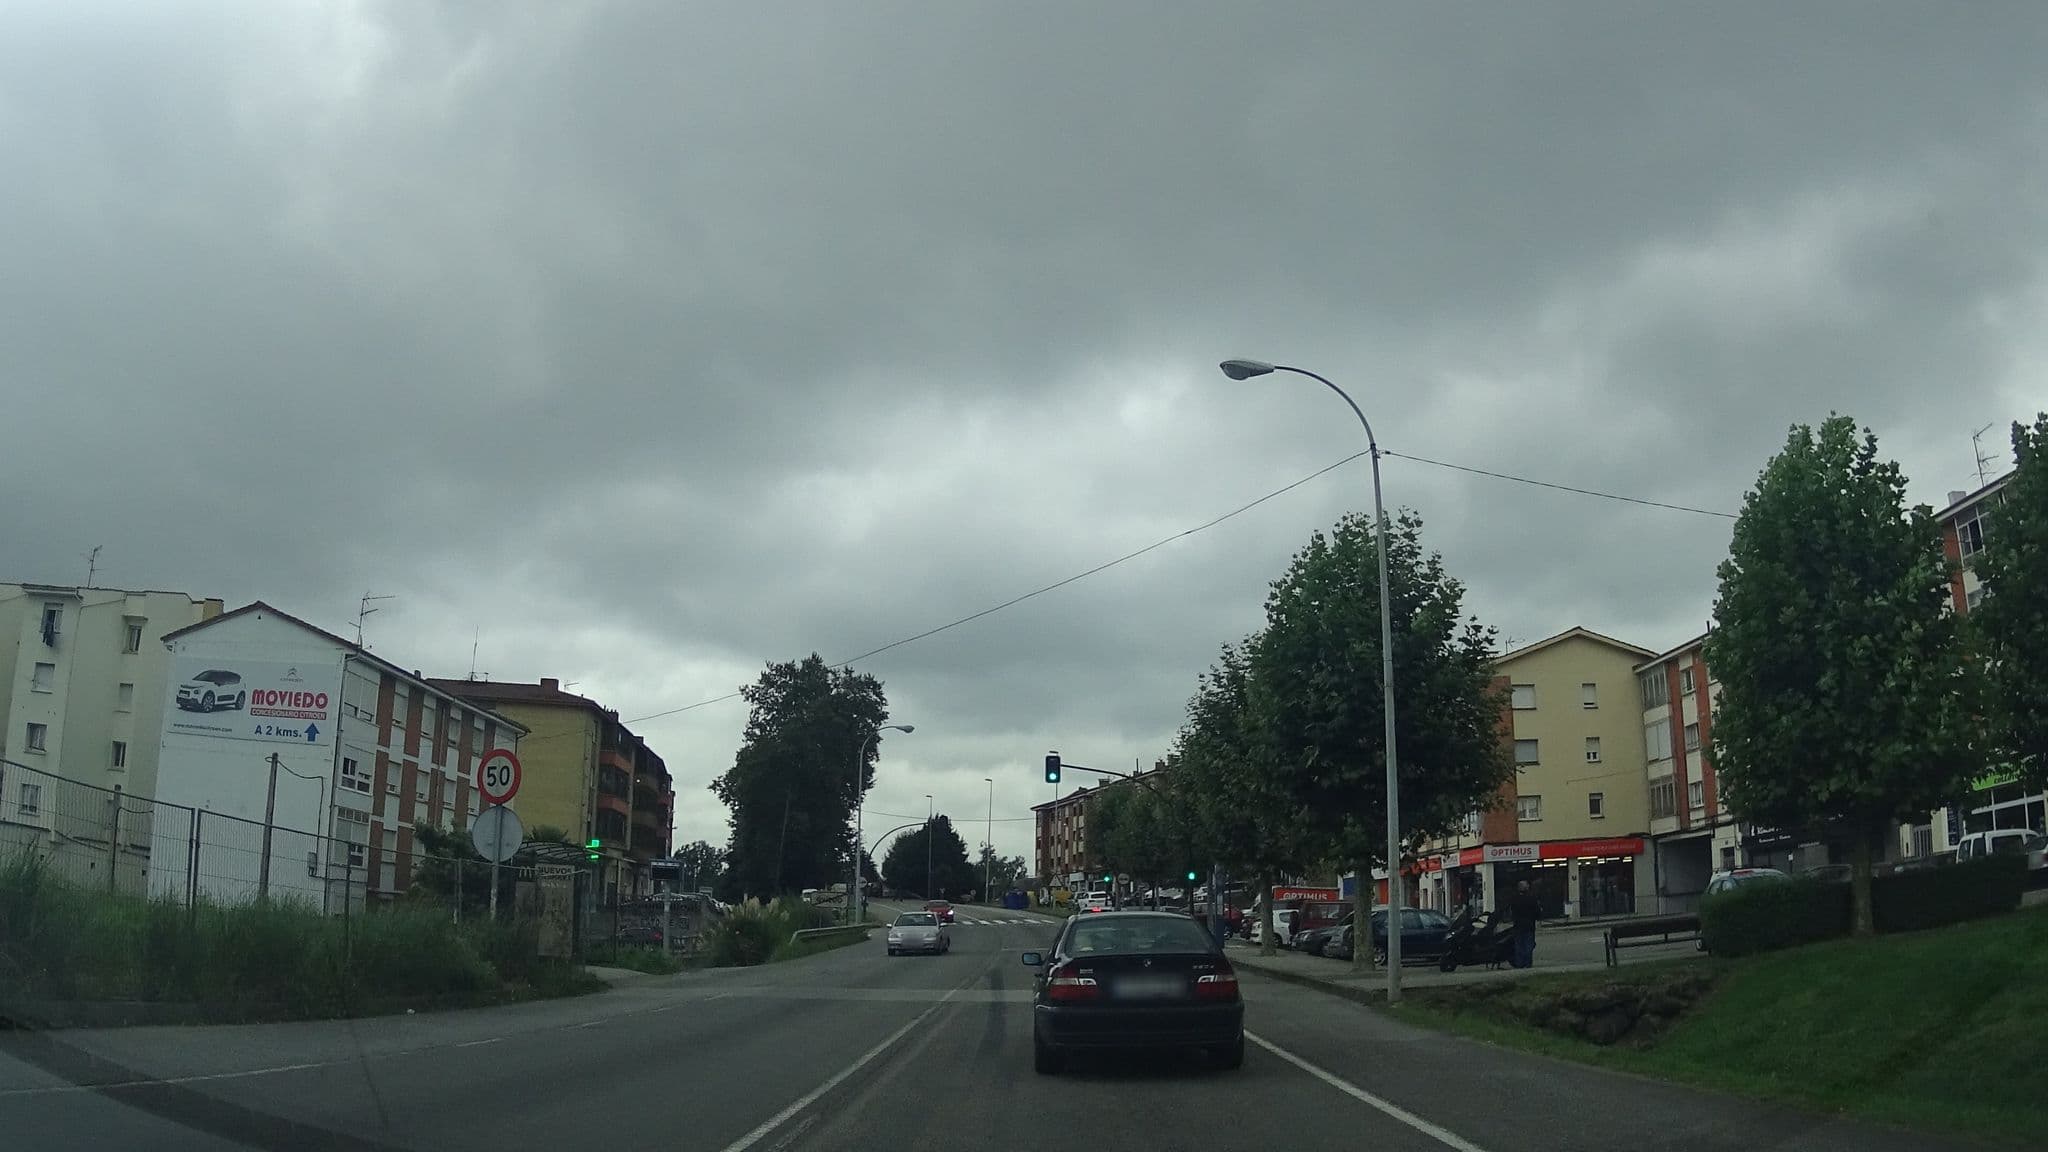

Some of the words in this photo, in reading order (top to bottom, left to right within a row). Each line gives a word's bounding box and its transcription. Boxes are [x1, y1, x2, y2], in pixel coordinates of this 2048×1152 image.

[252, 689, 328, 709] MOVIEDO
[255, 725, 262, 736] A
[266, 726, 273, 736] 2
[275, 727, 302, 738] kms.
[486, 766, 510, 787] 50
[1491, 847, 1532, 857] OPTIMUS
